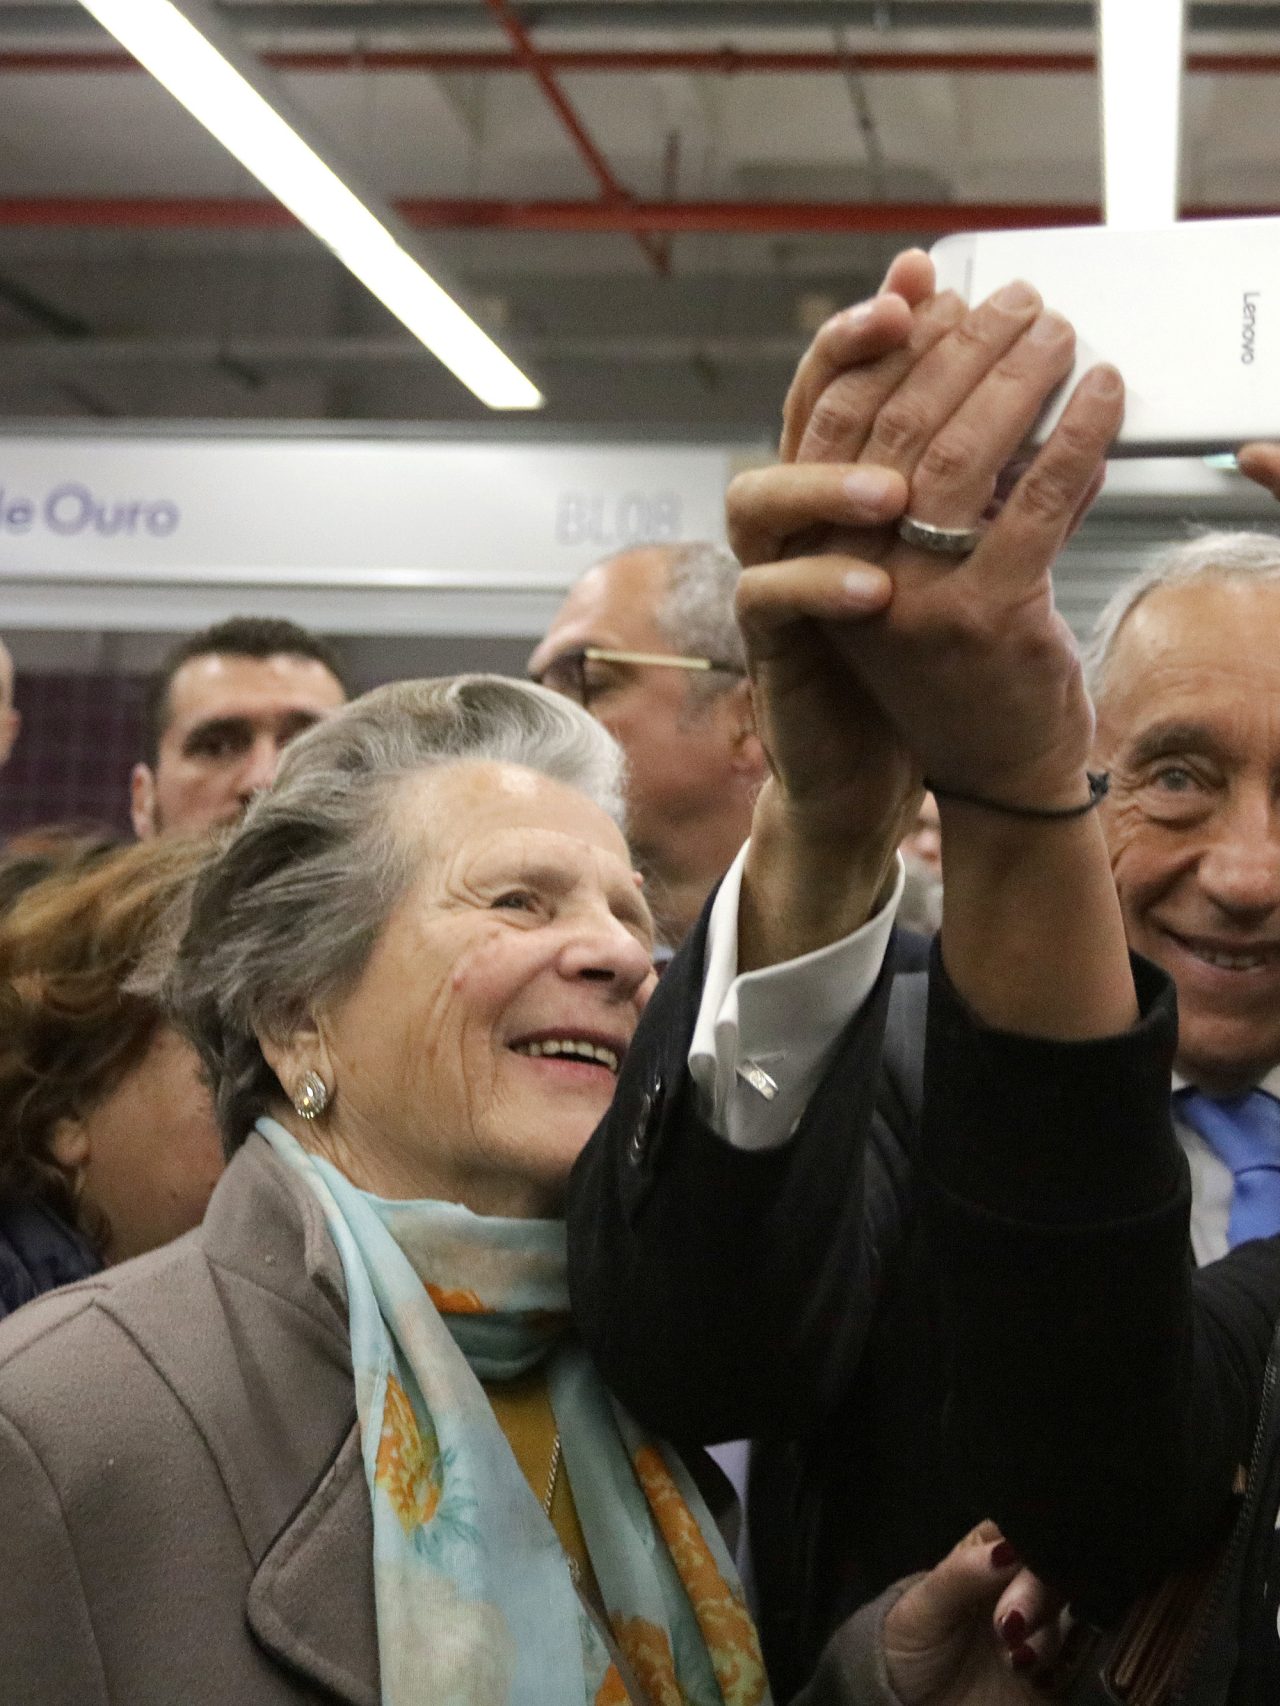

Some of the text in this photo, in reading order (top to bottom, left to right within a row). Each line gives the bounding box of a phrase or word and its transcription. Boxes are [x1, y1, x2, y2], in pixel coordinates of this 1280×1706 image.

[1241, 291, 1261, 365] Lenovo
[0, 480, 181, 538] e Ouro
